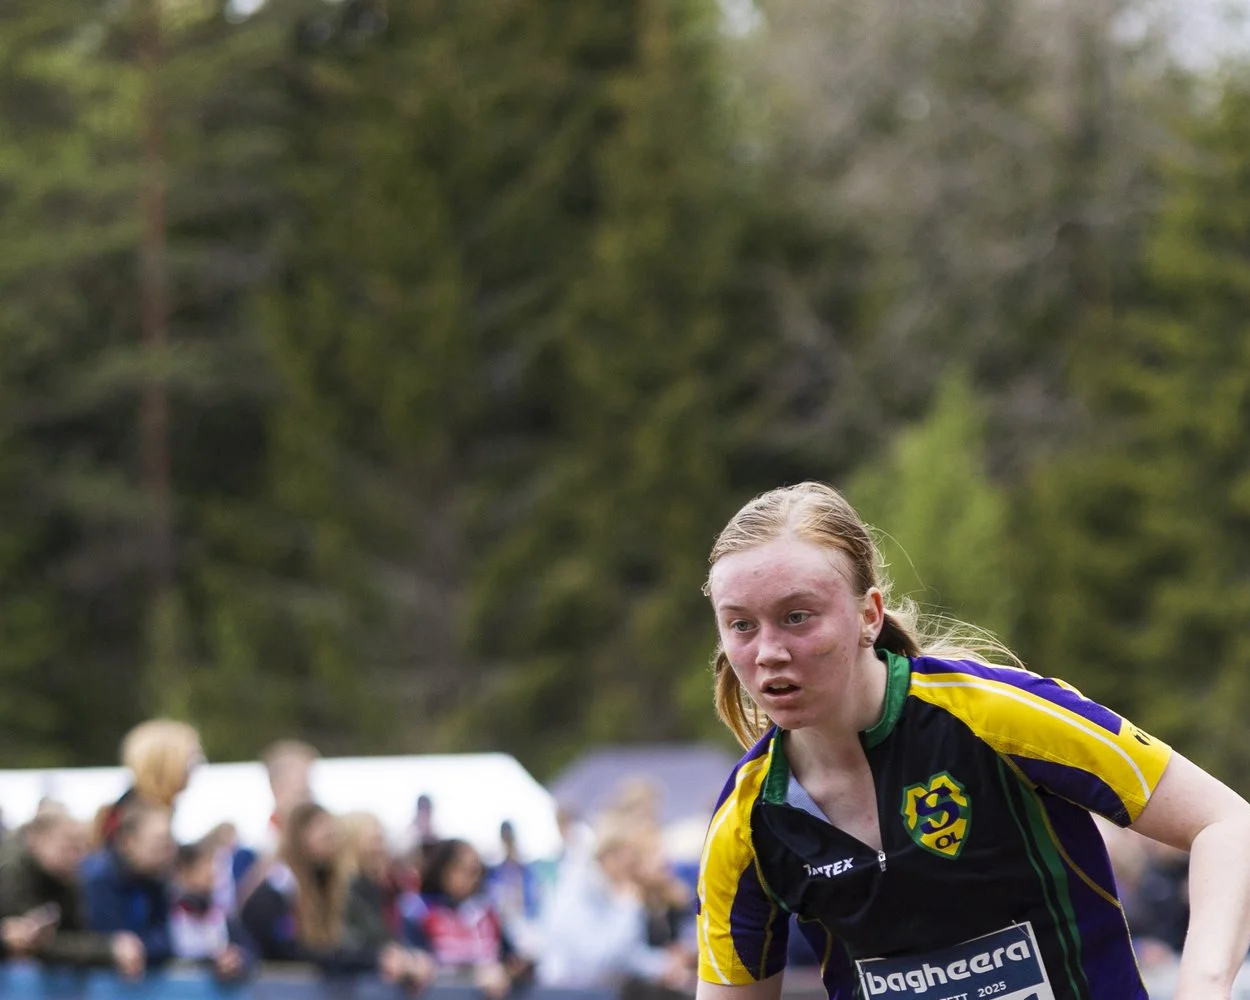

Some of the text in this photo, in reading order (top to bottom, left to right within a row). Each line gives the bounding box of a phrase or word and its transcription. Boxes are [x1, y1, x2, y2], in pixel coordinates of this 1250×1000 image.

[934, 832, 962, 850] OL
[865, 939, 1032, 995] bagheera
[978, 980, 1007, 998] 2025
